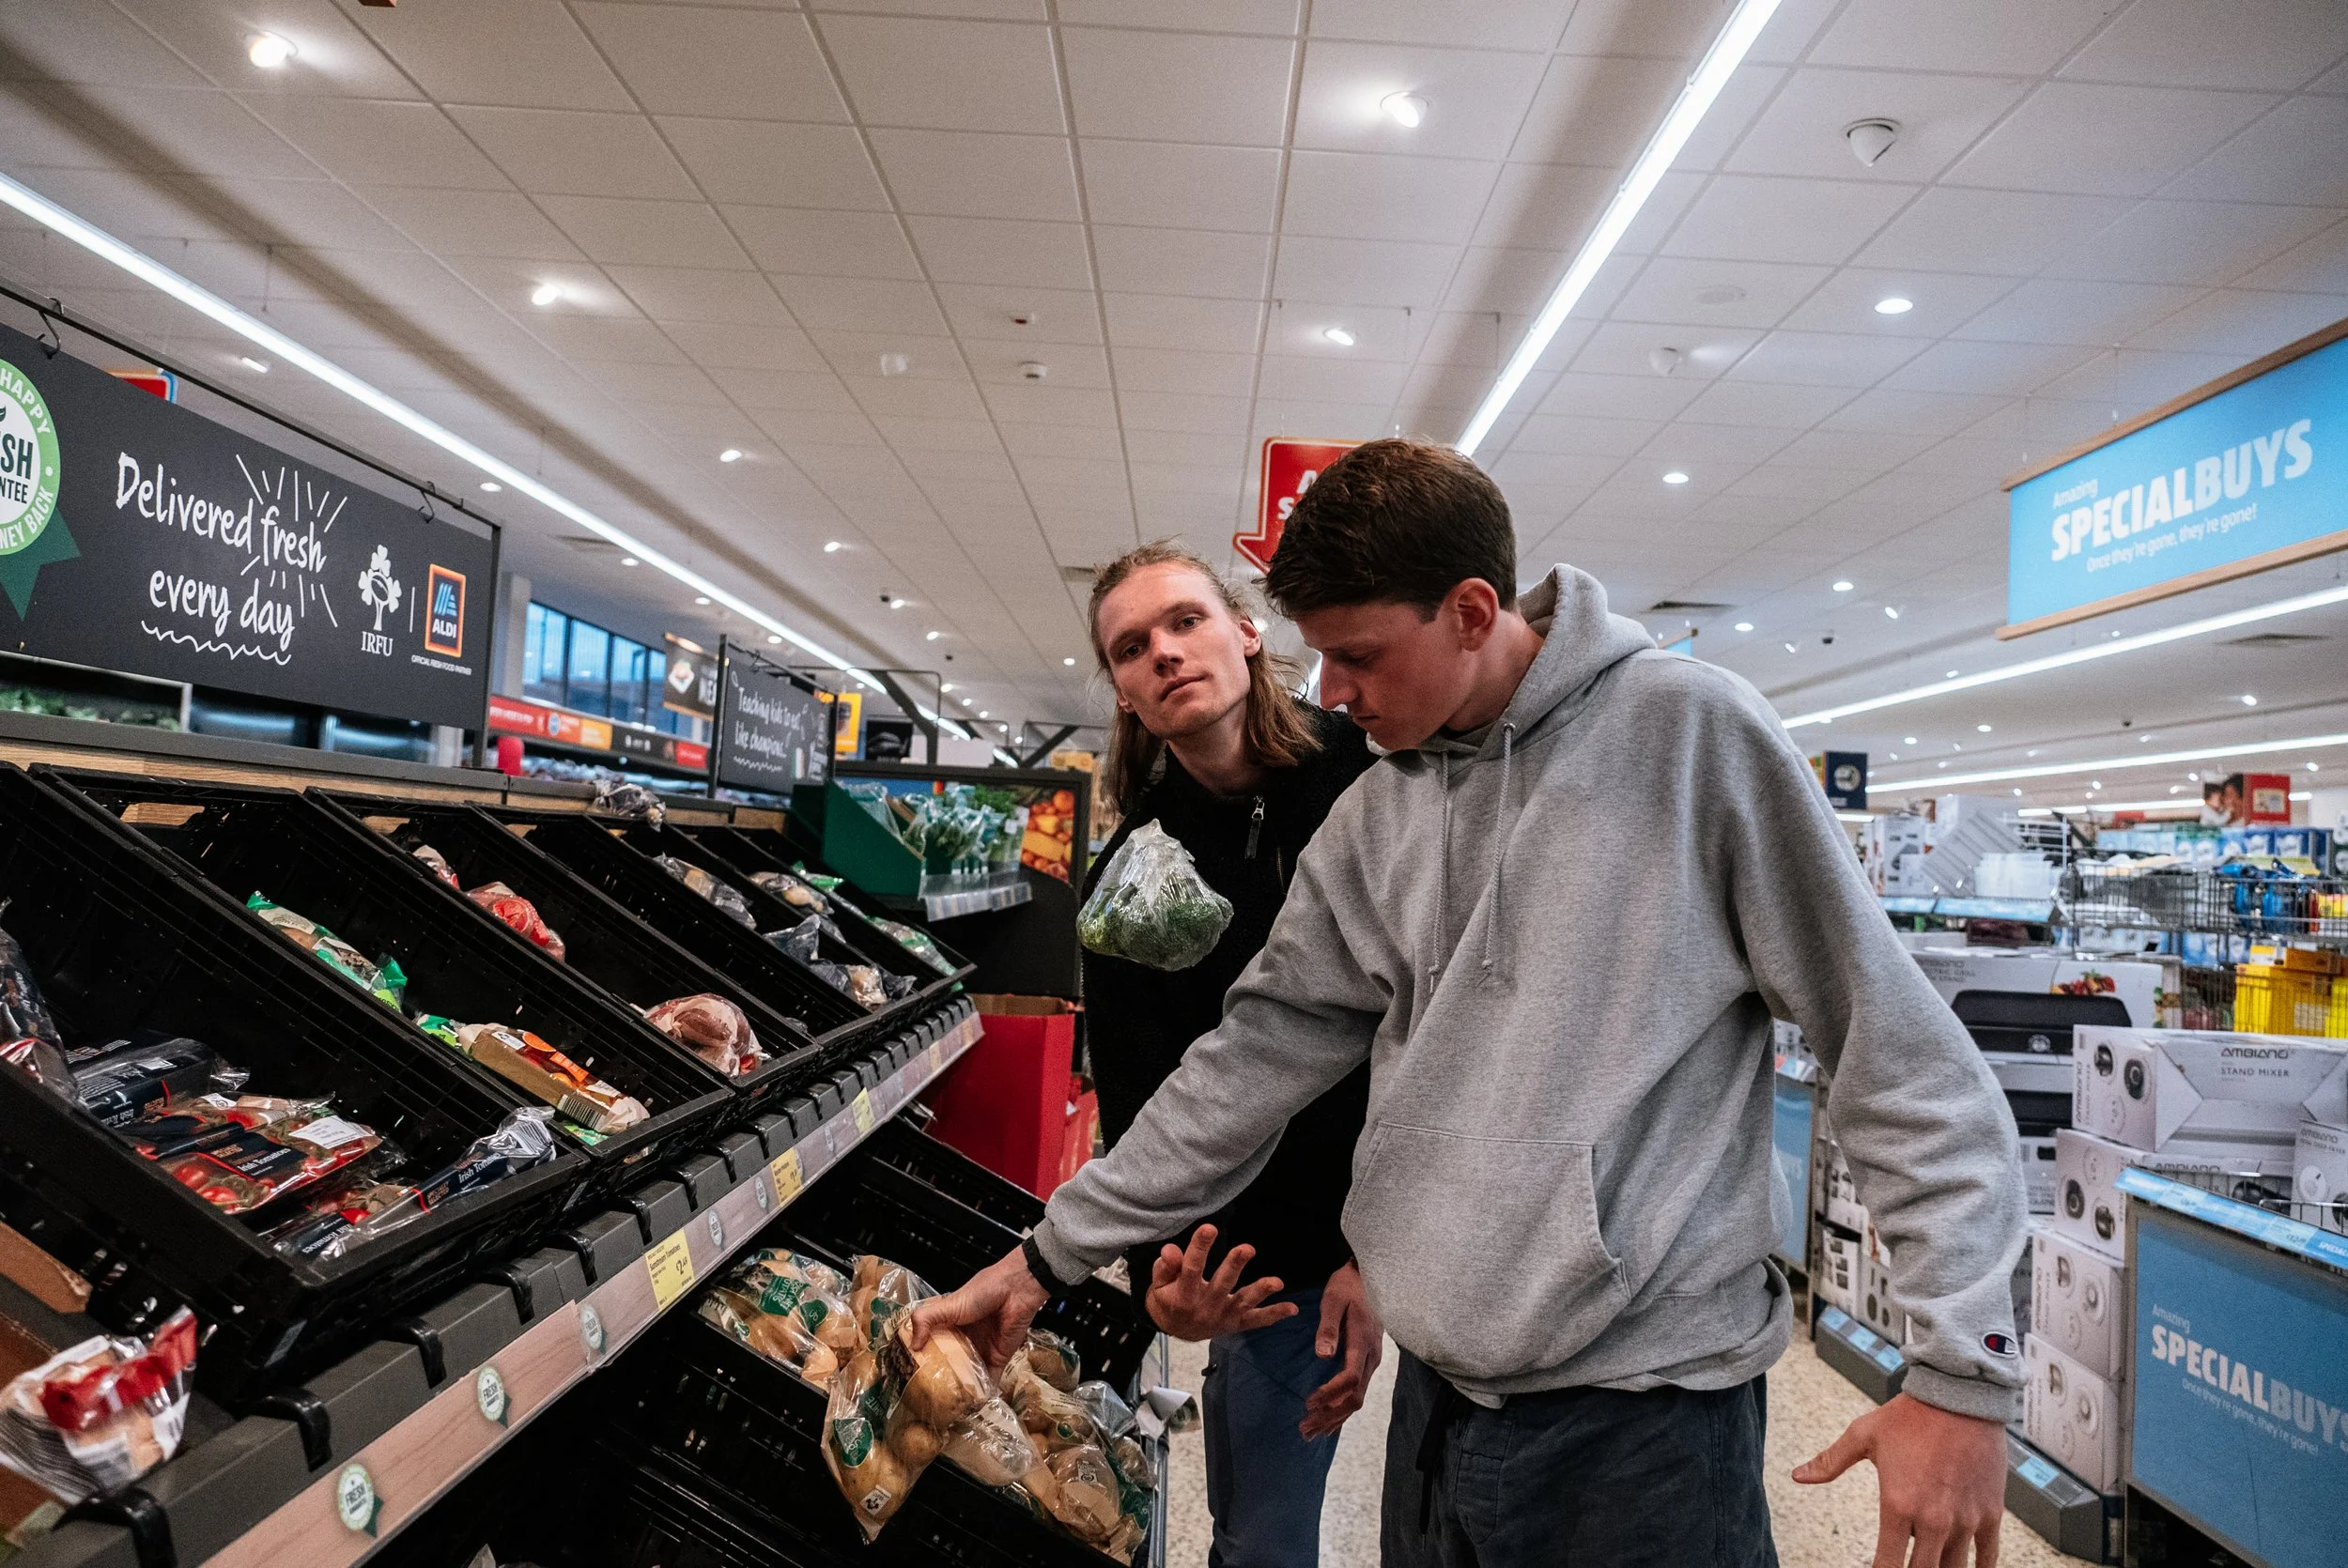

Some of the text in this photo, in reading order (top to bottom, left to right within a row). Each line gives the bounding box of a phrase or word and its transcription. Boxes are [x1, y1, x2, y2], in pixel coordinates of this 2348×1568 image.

[0, 367, 51, 434] HAPPY
[0, 433, 33, 480] SH
[2051, 419, 2313, 562] SPECIALBUYS
[23, 484, 54, 534] BACK
[116, 452, 327, 574] Delivered fresh
[149, 570, 296, 652] every day
[361, 631, 394, 656] IRFU
[432, 619, 457, 638] ALDI
[2220, 1047, 2289, 1060] AMBIANO
[2221, 1067, 2254, 1076] STAND
[2258, 1068, 2289, 1078] MIXER
[237, 1159, 256, 1172] Irish
[458, 1167, 474, 1184] Irish
[2152, 1303, 2190, 1334] Amazing
